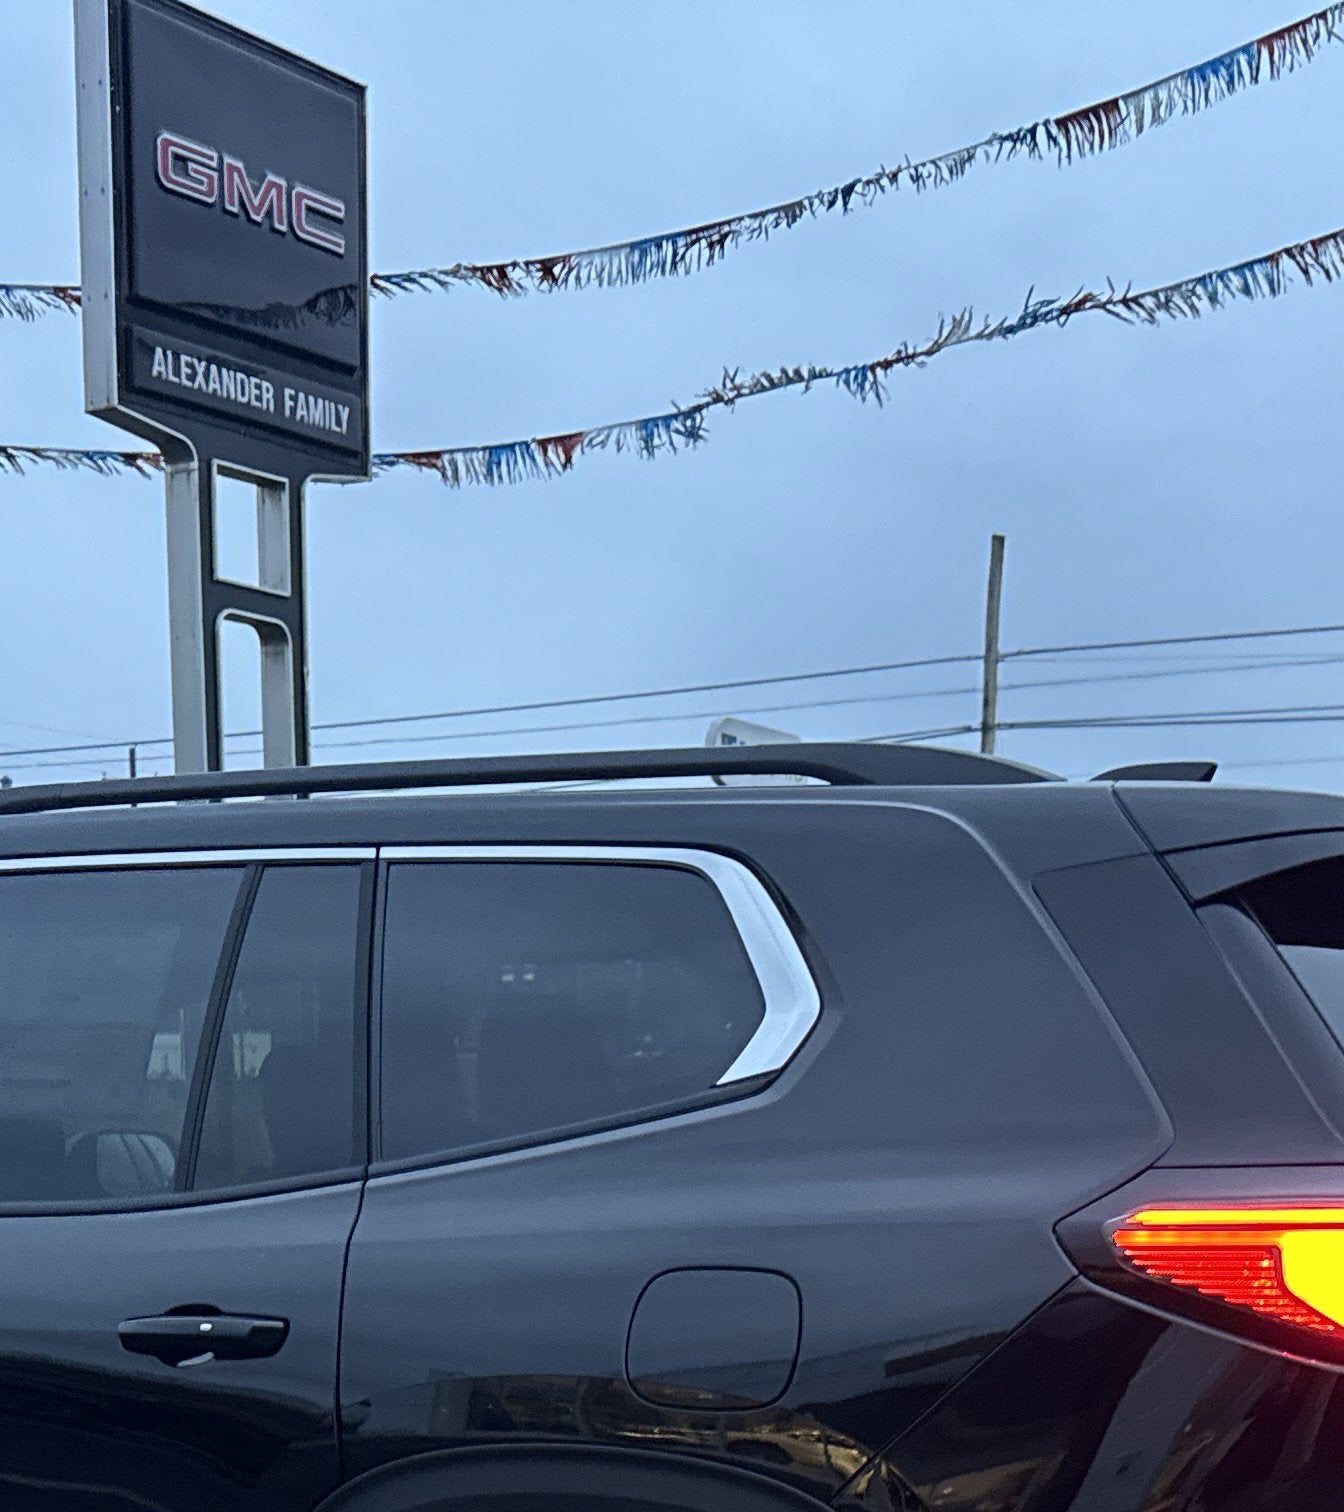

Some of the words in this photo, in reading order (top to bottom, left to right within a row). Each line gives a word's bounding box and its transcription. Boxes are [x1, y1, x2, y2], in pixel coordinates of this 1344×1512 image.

[157, 133, 346, 255] GMC
[152, 346, 275, 413] ALEXANDER
[284, 388, 350, 434] FAMILY
